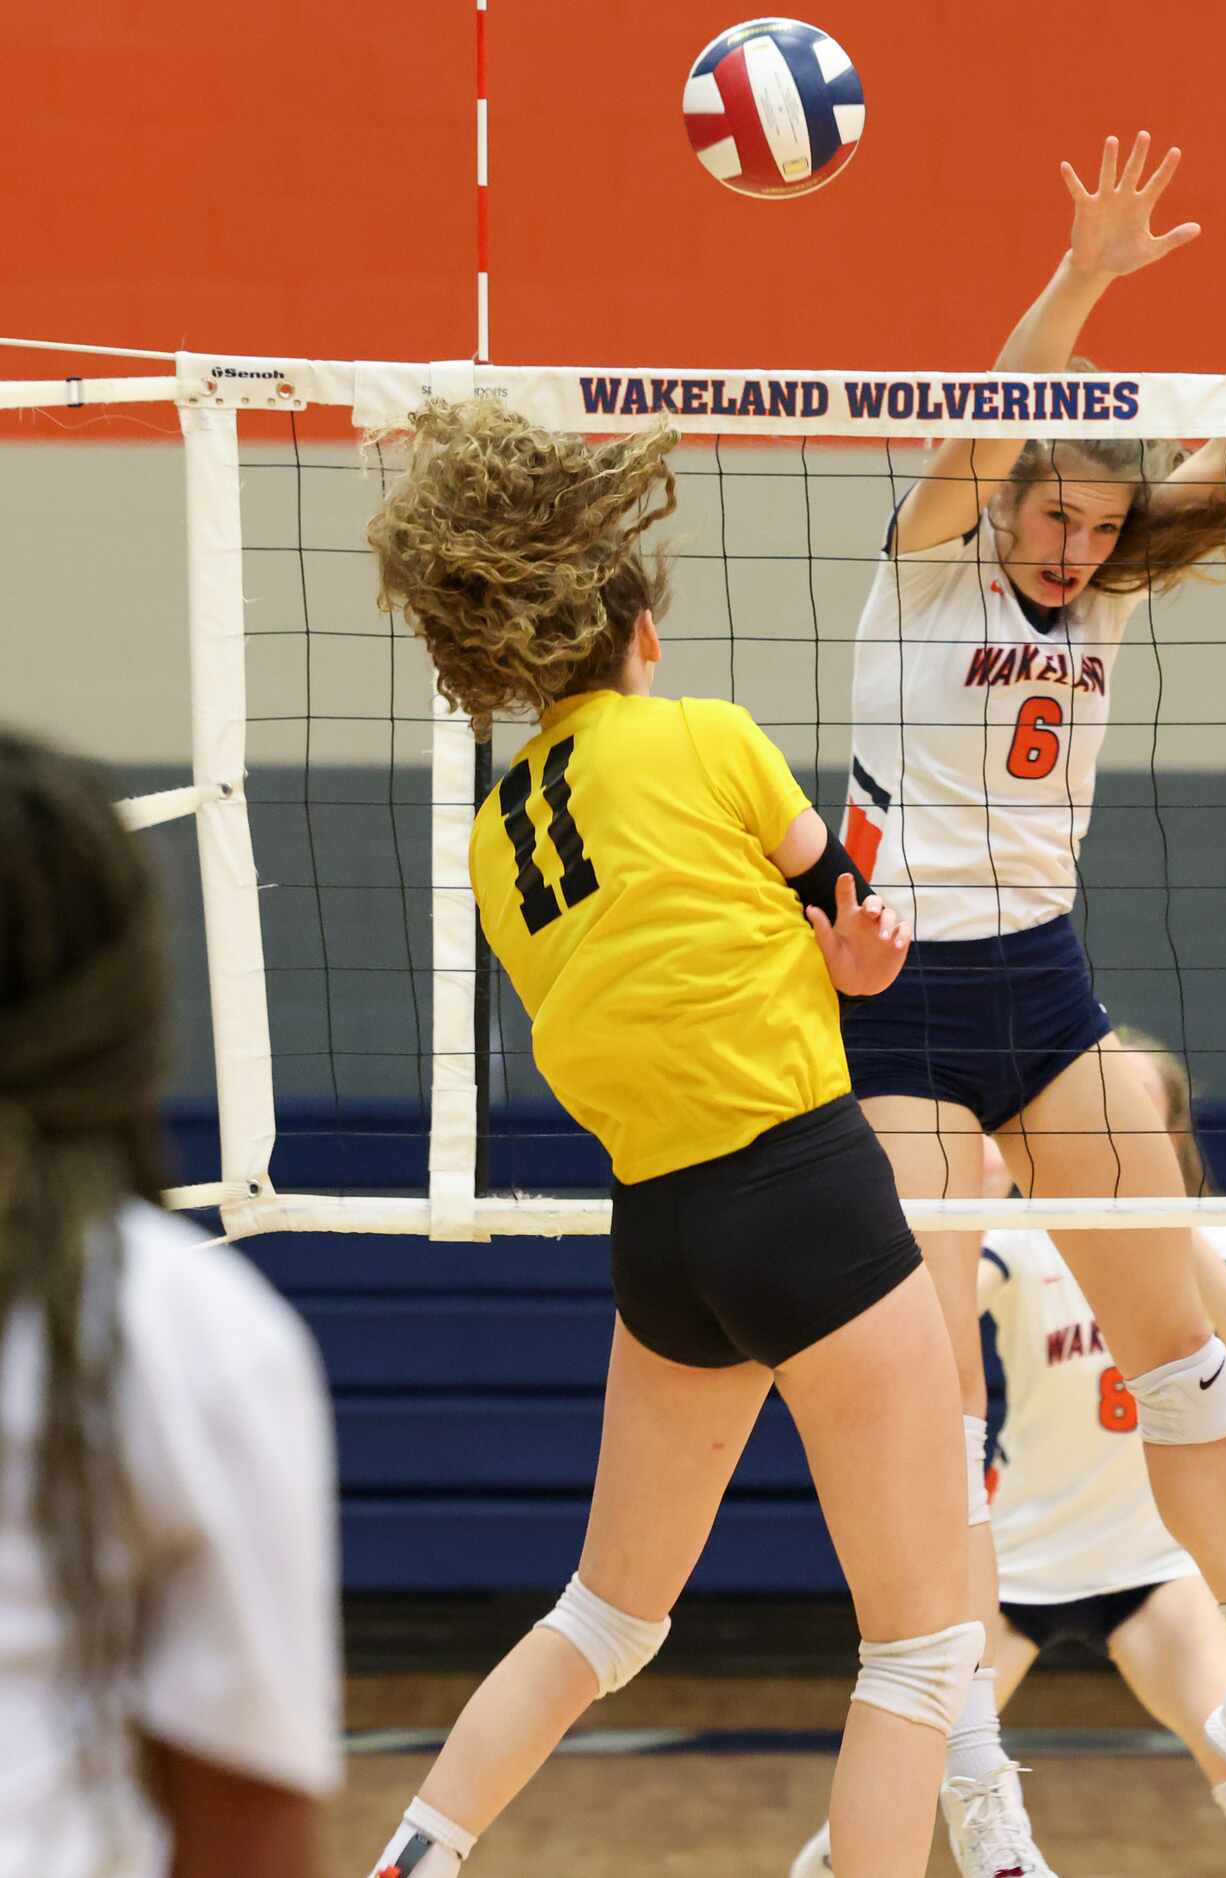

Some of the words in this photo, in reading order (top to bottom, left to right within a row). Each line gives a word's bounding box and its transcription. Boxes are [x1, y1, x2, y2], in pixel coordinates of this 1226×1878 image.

[224, 367, 285, 379] Senoh
[579, 377, 829, 418] WAKELAND
[844, 381, 1139, 421] WOLVERINES
[1006, 695, 1064, 780] 6
[499, 734, 600, 937] 11
